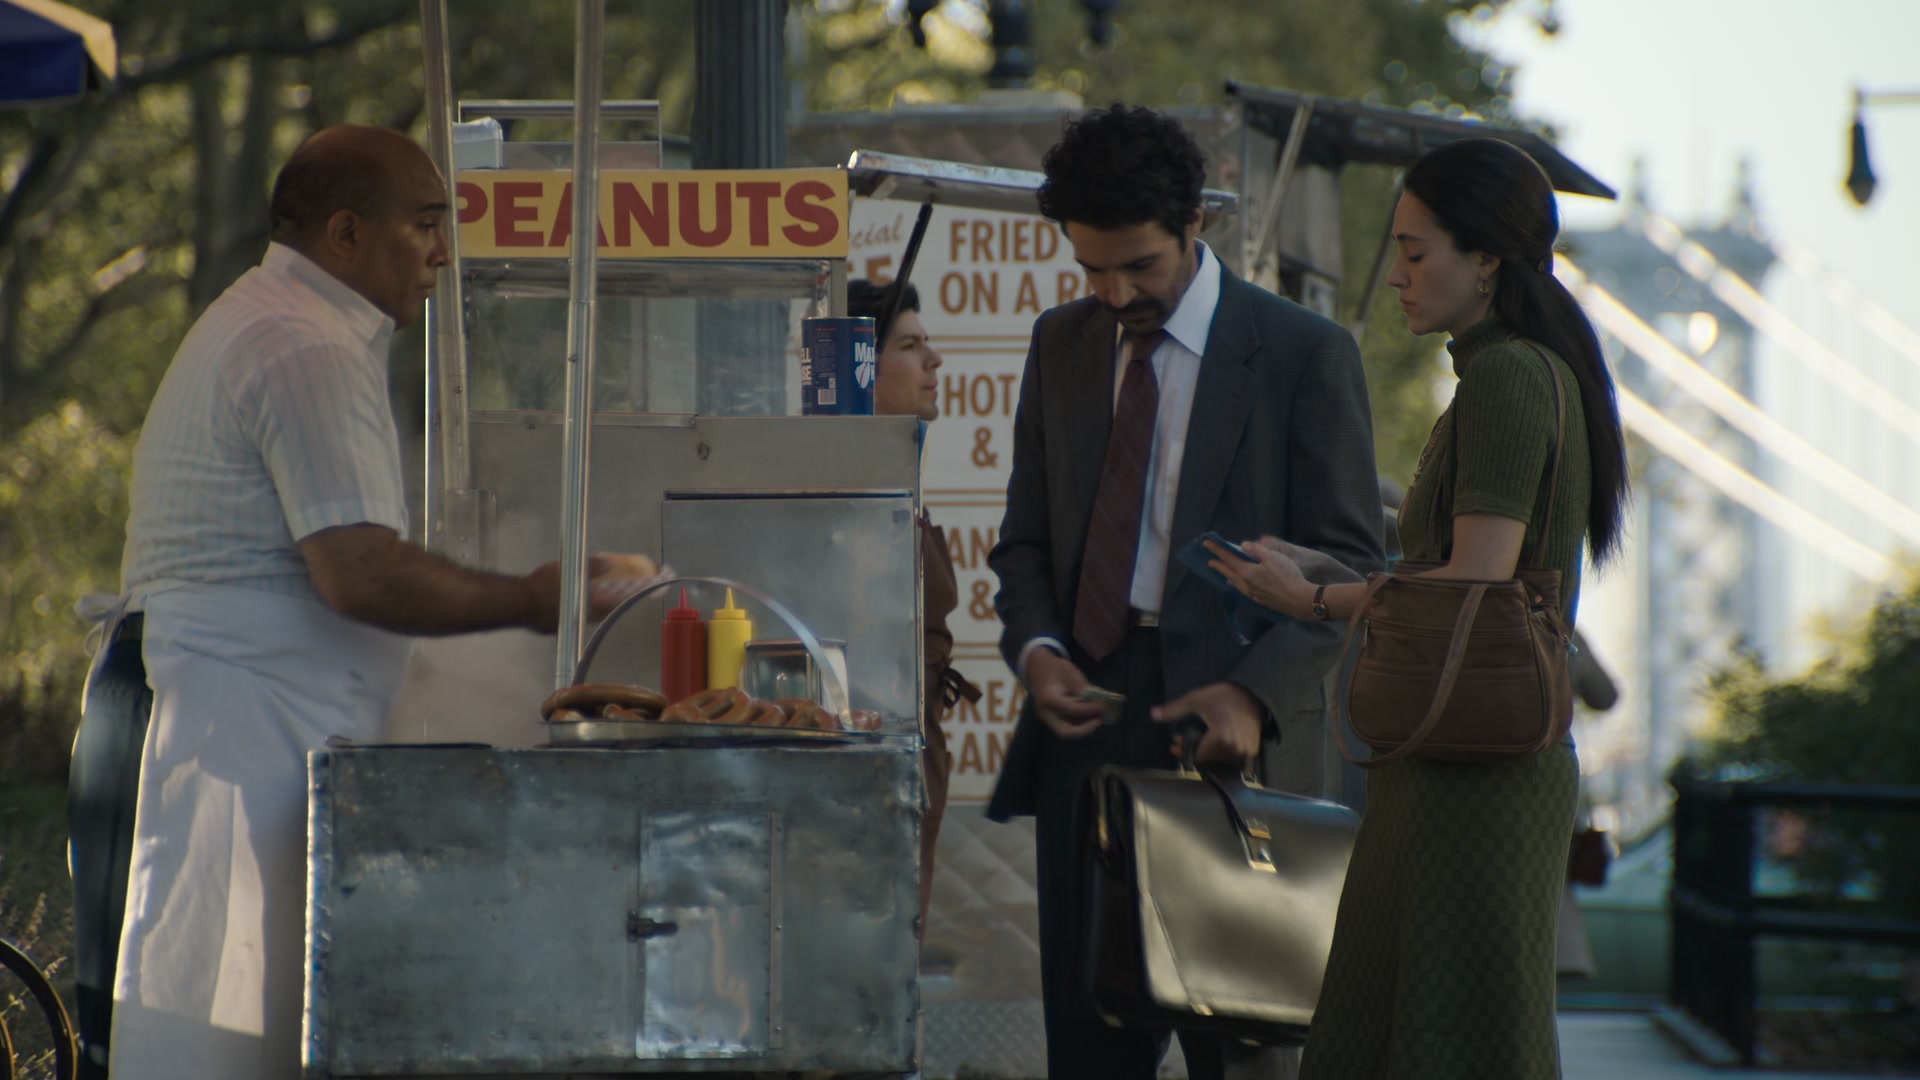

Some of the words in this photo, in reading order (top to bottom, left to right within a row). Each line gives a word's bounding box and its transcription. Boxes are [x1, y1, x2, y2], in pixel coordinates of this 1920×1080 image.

[456, 180, 840, 248] PEANUTS
[850, 216, 903, 249] cial
[950, 219, 1059, 263] FRIED
[939, 270, 998, 316] ON
[1014, 271, 1042, 315] A
[1057, 271, 1094, 307] R
[944, 373, 1017, 418] HOT
[971, 426, 999, 469] &
[947, 526, 999, 570] AN
[968, 579, 997, 622] &
